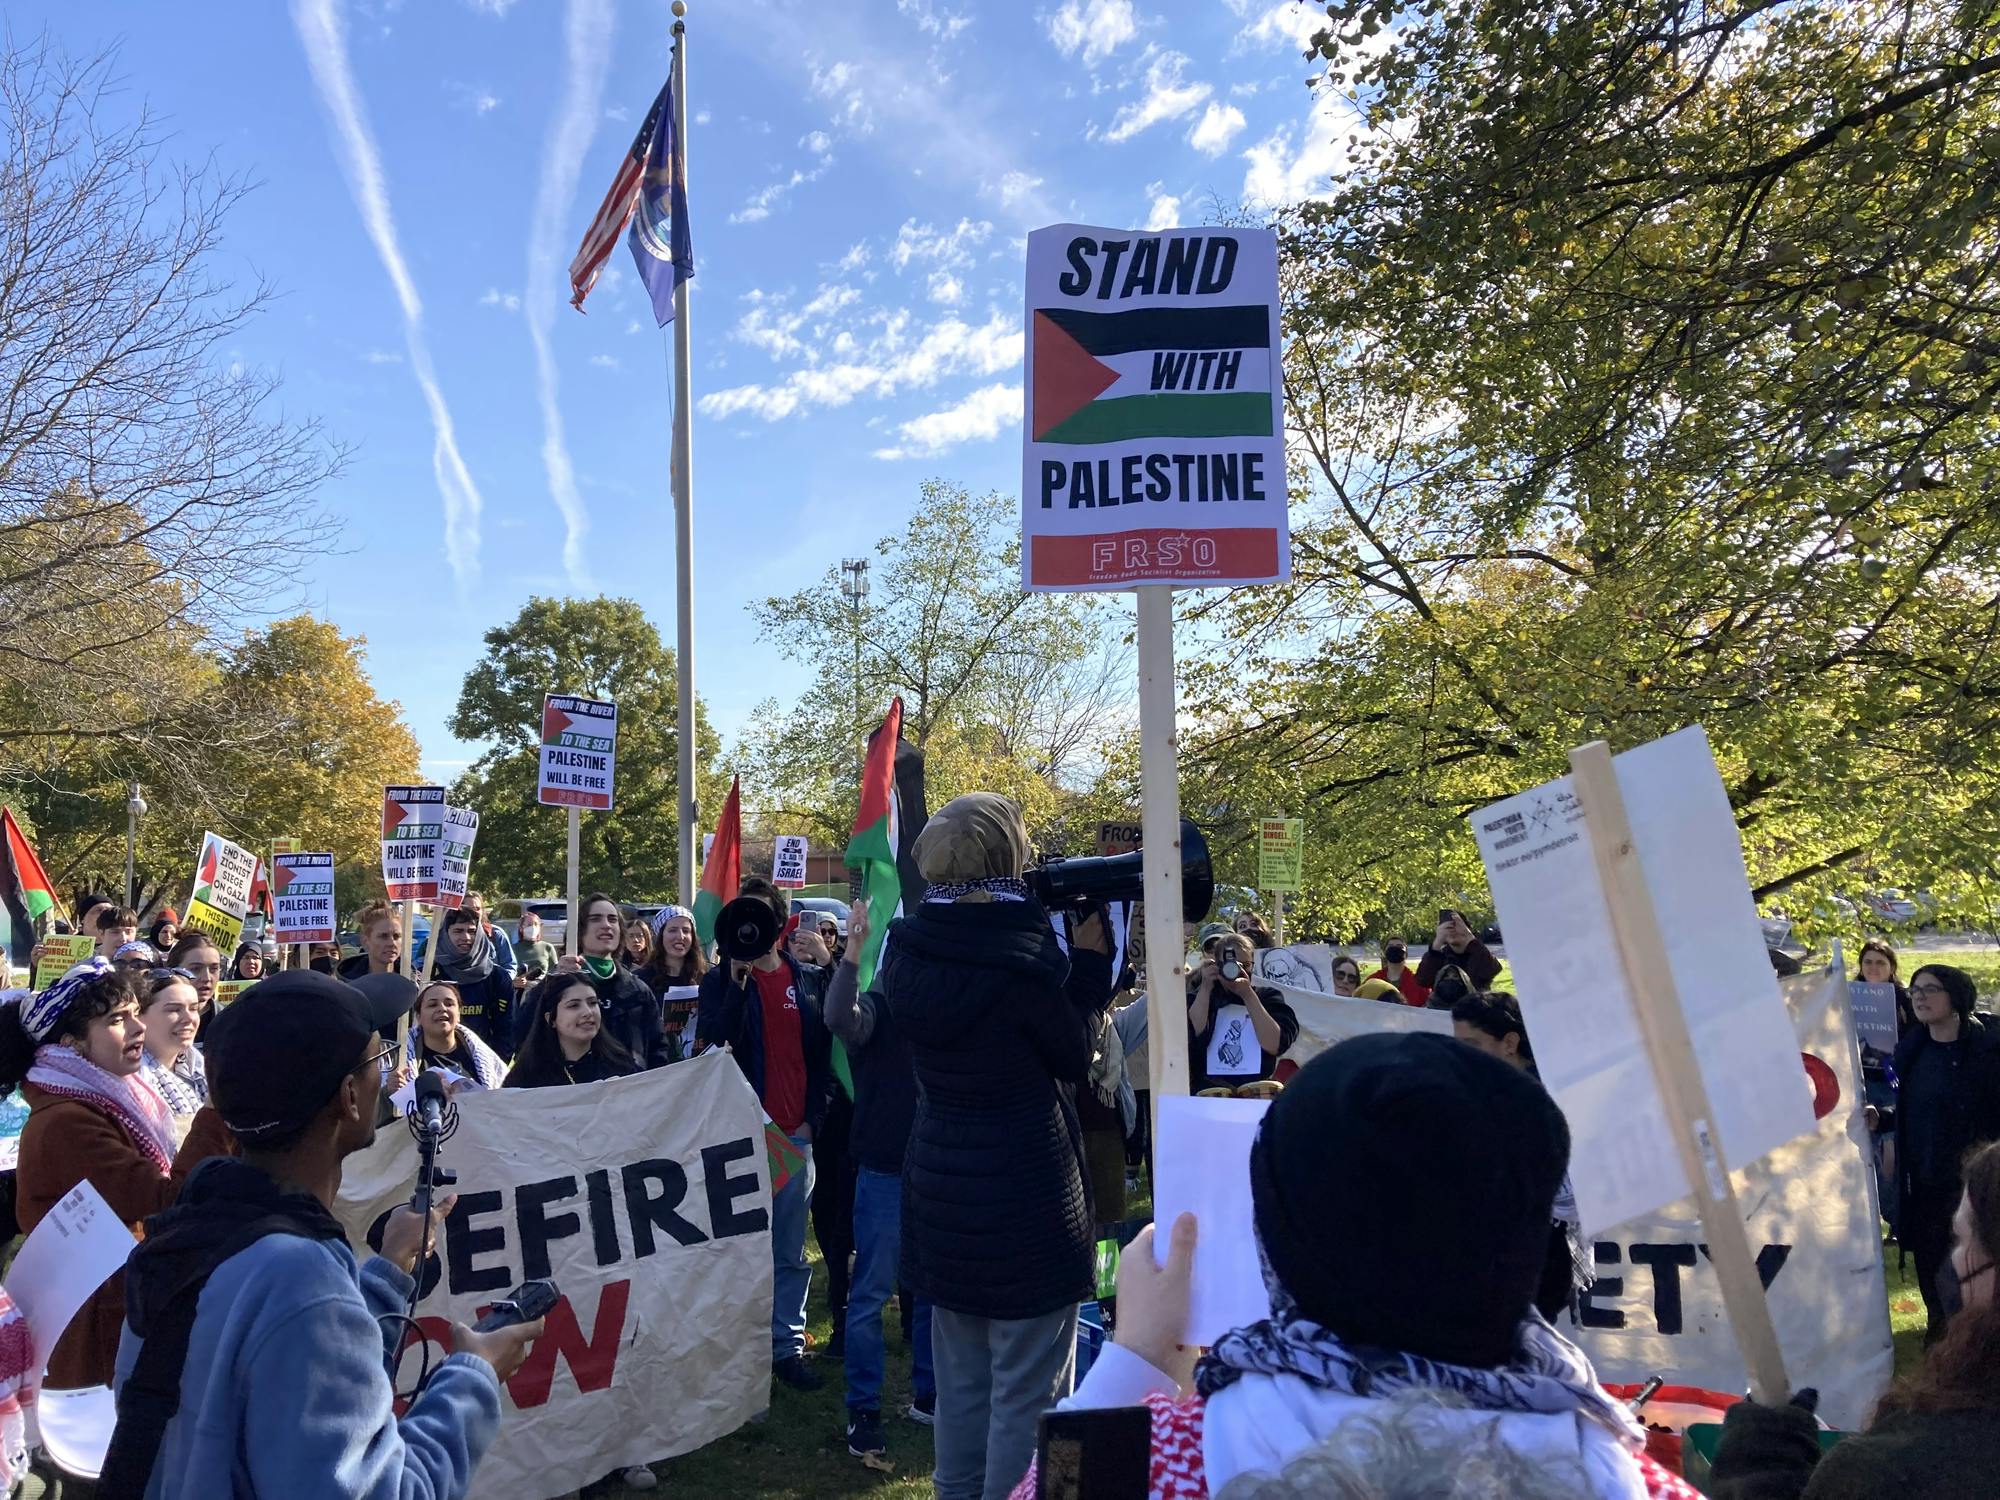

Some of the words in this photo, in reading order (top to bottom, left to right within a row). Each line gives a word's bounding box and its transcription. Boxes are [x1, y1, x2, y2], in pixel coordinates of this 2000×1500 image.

[1059, 237, 1238, 299] STAND
[1150, 351, 1242, 390] WITH
[1042, 453, 1265, 509] PALESTINE
[1121, 570, 1137, 578] Road
[1140, 568, 1172, 576] Socialist
[548, 699, 574, 710] FROM
[575, 701, 590, 714] THE
[590, 704, 614, 717] RIVER
[560, 733, 573, 746] TO
[574, 735, 590, 748] THE
[591, 738, 611, 751] SEA
[548, 751, 606, 771] PALESTINE
[547, 771, 568, 784] WILL
[571, 774, 582, 786] BE
[584, 776, 606, 789] FREE
[388, 790, 408, 800] FROM
[409, 790, 420, 800] THE
[421, 790, 443, 800] RIVER
[396, 826, 406, 838] TO
[409, 825, 421, 838] THE
[421, 825, 439, 838] SEA
[451, 843, 466, 856] THE
[786, 838, 800, 848] END
[223, 845, 239, 860] END
[240, 854, 253, 868] THE
[387, 845, 435, 859] PALESTINE
[276, 857, 297, 866] FROM
[297, 856, 310, 865] THE
[311, 856, 331, 865] RIVER
[220, 857, 251, 880] ZIONIST
[387, 867, 404, 879] WILL
[406, 867, 416, 878] BE
[417, 866, 434, 878] FREE
[776, 868, 803, 879] ISRAEL
[222, 870, 244, 889] SIEGE
[213, 880, 226, 892] ON
[226, 885, 246, 903] GAZA
[288, 884, 298, 894] TO
[300, 884, 313, 894] THE
[315, 883, 331, 893] SEA
[216, 894, 241, 913] NOW!!
[279, 899, 328, 912] PALESTINE
[205, 908, 220, 923] THIS
[220, 916, 229, 927] IS
[279, 917, 297, 927] WILL
[300, 916, 309, 925] BE
[311, 916, 328, 925] FREE
[46, 938, 72, 947] DEBBIE
[1851, 987, 1884, 996] STAND
[1851, 1005, 1878, 1013] WITH
